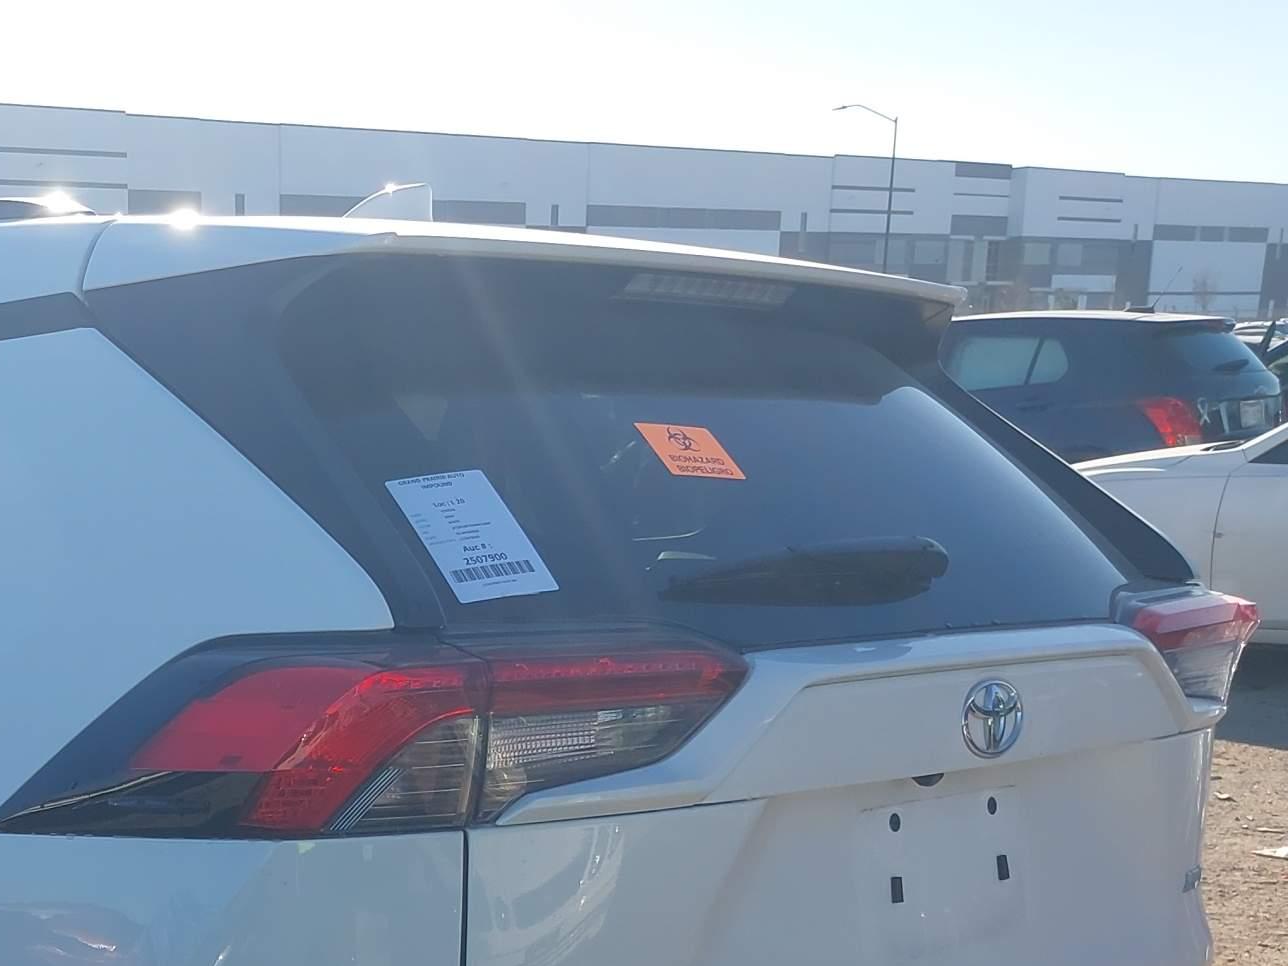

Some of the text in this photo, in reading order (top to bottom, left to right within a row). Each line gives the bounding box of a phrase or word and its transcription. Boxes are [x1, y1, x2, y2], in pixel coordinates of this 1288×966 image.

[668, 454, 725, 465] BIOHAZARD
[676, 464, 734, 475] BIOPELIGRO
[463, 544, 481, 552] Auc
[463, 552, 508, 566] 2507900
